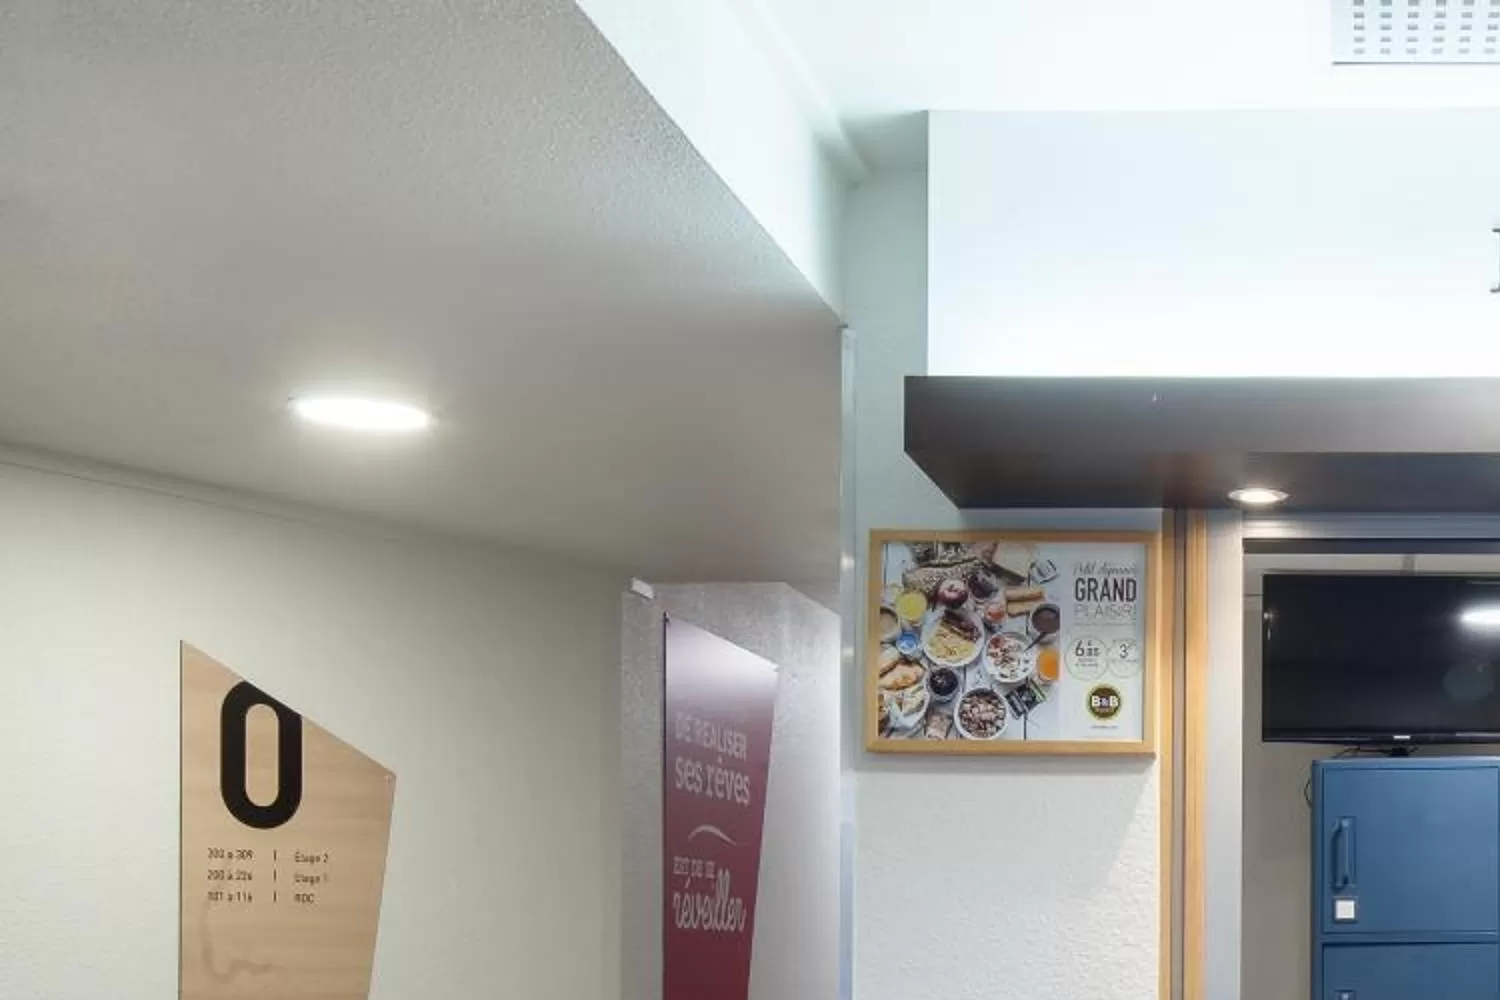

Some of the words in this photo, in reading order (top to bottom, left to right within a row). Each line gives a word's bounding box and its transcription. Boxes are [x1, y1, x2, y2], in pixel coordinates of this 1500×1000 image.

[1075, 577, 1137, 602] GRAND
[220, 680, 303, 829] 0
[674, 755, 703, 795] ses
